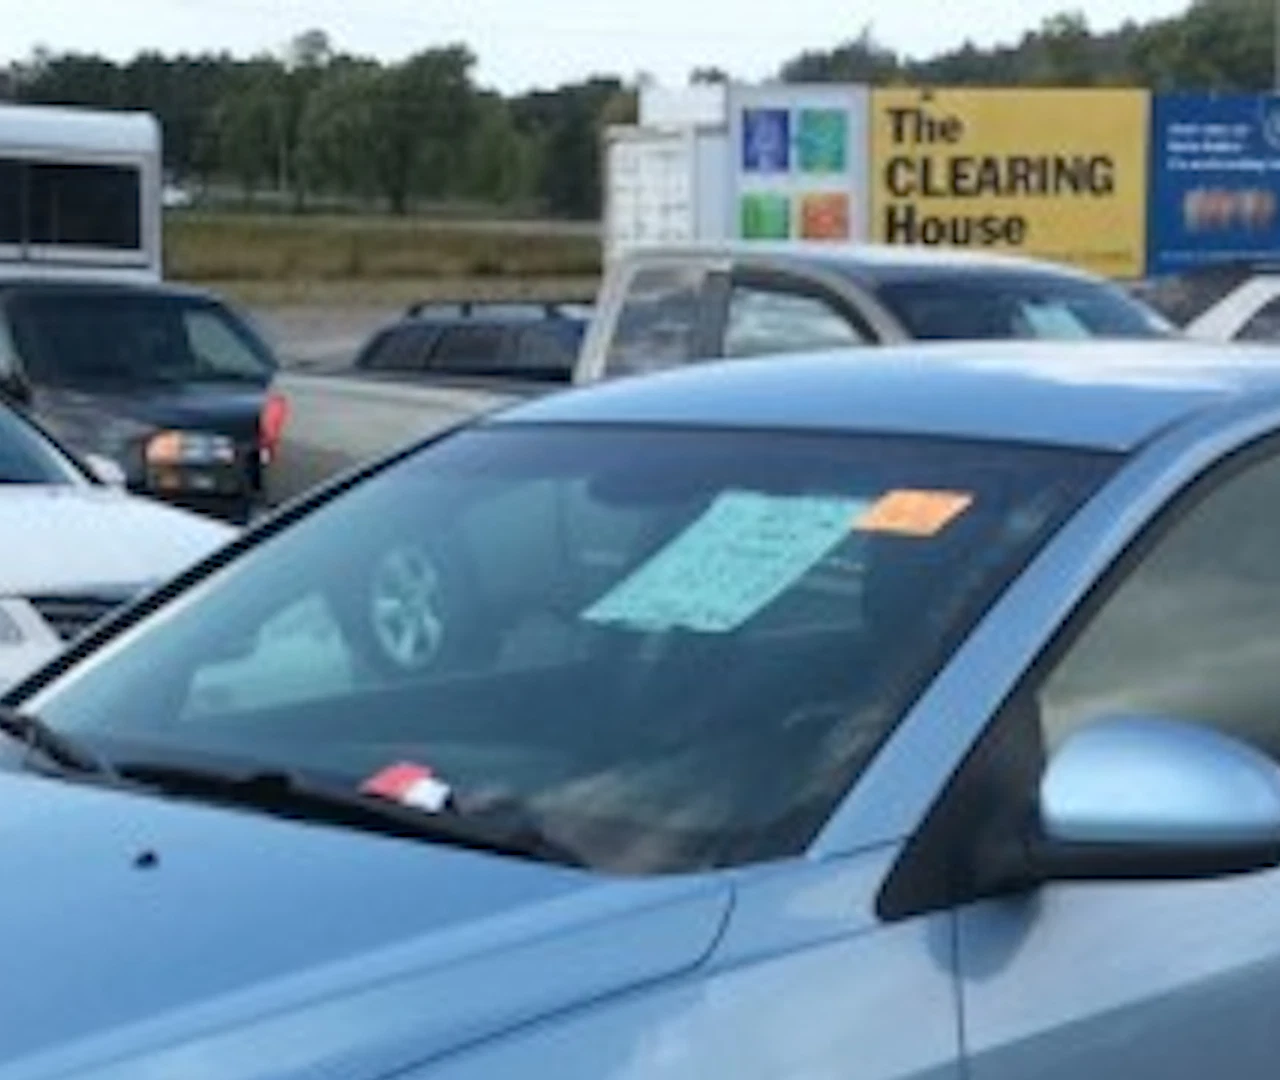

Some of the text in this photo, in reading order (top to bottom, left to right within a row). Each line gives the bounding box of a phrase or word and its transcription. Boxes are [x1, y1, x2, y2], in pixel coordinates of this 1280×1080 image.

[887, 106, 963, 144] The
[885, 154, 1115, 197] CLEARING
[885, 203, 1029, 245] House
